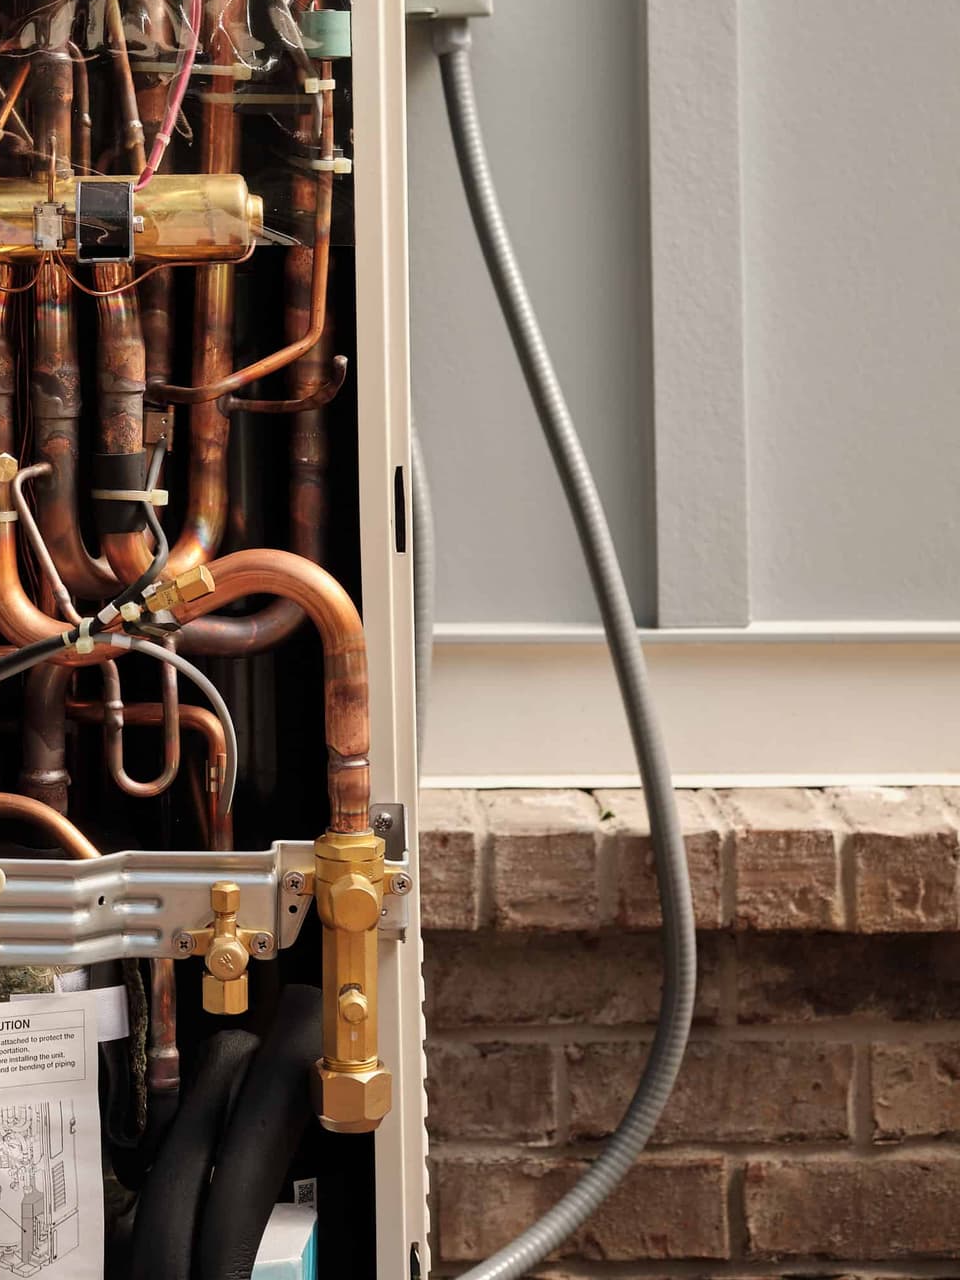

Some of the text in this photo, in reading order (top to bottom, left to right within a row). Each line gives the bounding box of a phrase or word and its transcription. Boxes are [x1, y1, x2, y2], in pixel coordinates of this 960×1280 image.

[1, 1037, 29, 1046] attached
[39, 1034, 63, 1043] protect
[9, 1055, 38, 1064] installing
[19, 1063, 45, 1073] bending
[55, 1060, 76, 1069] piping
